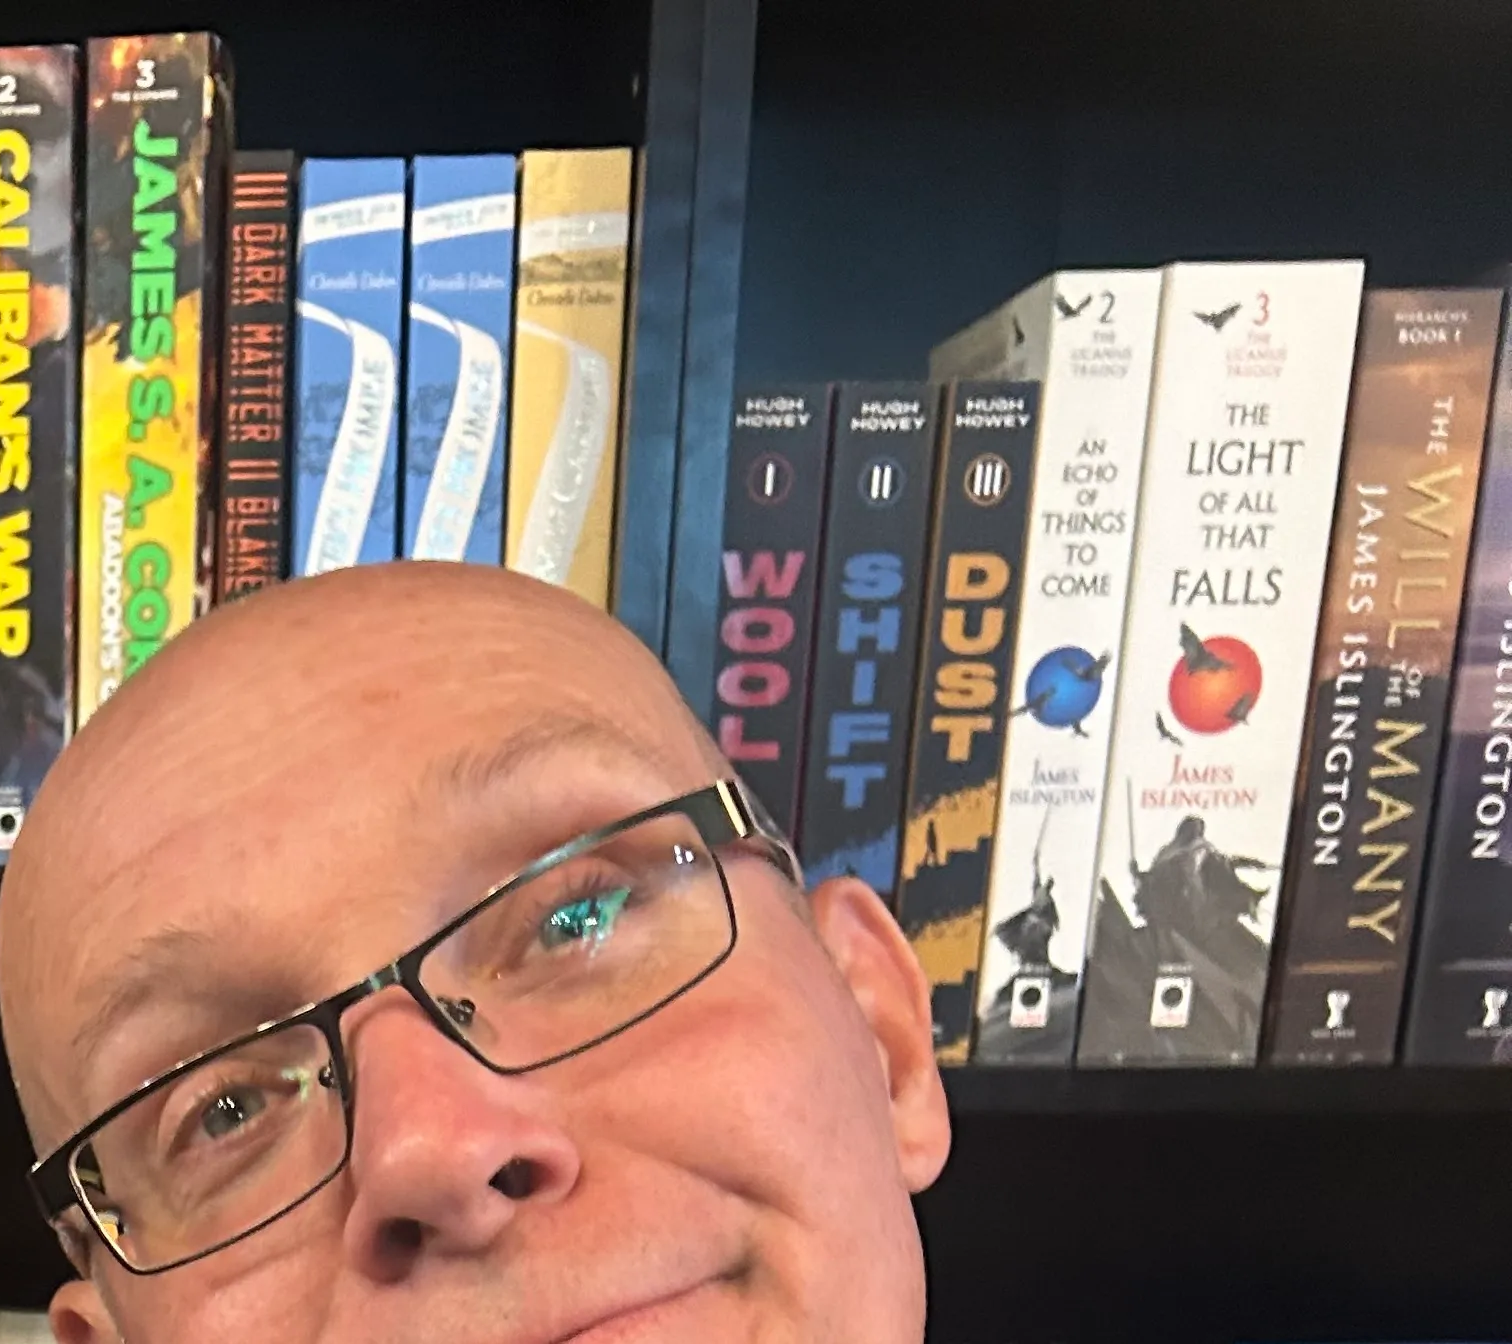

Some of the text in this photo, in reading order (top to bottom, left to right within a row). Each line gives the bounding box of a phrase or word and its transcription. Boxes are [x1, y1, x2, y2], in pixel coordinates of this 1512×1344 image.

[136, 59, 155, 88] 3
[232, 223, 288, 305] DARK
[1100, 290, 1117, 324] 2
[1252, 290, 1272, 327] 3
[125, 118, 179, 529] JAMES S. A.
[1398, 327, 1447, 345] BOOK
[226, 325, 284, 443] MATTER
[746, 397, 805, 413] HUGH
[861, 400, 921, 416] HUGH
[966, 397, 1025, 413] HUGH
[1226, 403, 1272, 428] THE
[736, 412, 812, 429] HOWEY
[851, 415, 926, 432] HOWEY
[955, 413, 1031, 430] HOWEY
[1425, 396, 1455, 457] THE
[1077, 440, 1107, 457] AN
[1187, 439, 1305, 478] LIGHT
[1062, 463, 1119, 484] ECHO
[1076, 489, 1100, 506] OF
[1199, 489, 1278, 515] OF ALL
[1042, 512, 1127, 536] THINGS
[1202, 524, 1274, 549] THAT
[1065, 543, 1099, 566] TO
[1387, 463, 1464, 651] WILL
[1041, 574, 1110, 598] COME
[1169, 566, 1284, 608] FALLS
[715, 550, 806, 762] WOOL
[931, 552, 1011, 763] DUST
[826, 552, 905, 811] SHIFT
[1313, 483, 1388, 865] JAMES ISLINGTON
[1384, 659, 1408, 708] THE
[1031, 758, 1080, 785] JAMES
[1170, 754, 1235, 786] JAMES
[1009, 787, 1096, 807] ISLINGTON
[1140, 788, 1257, 811] ISLINGTON
[1346, 718, 1428, 944] MANY
